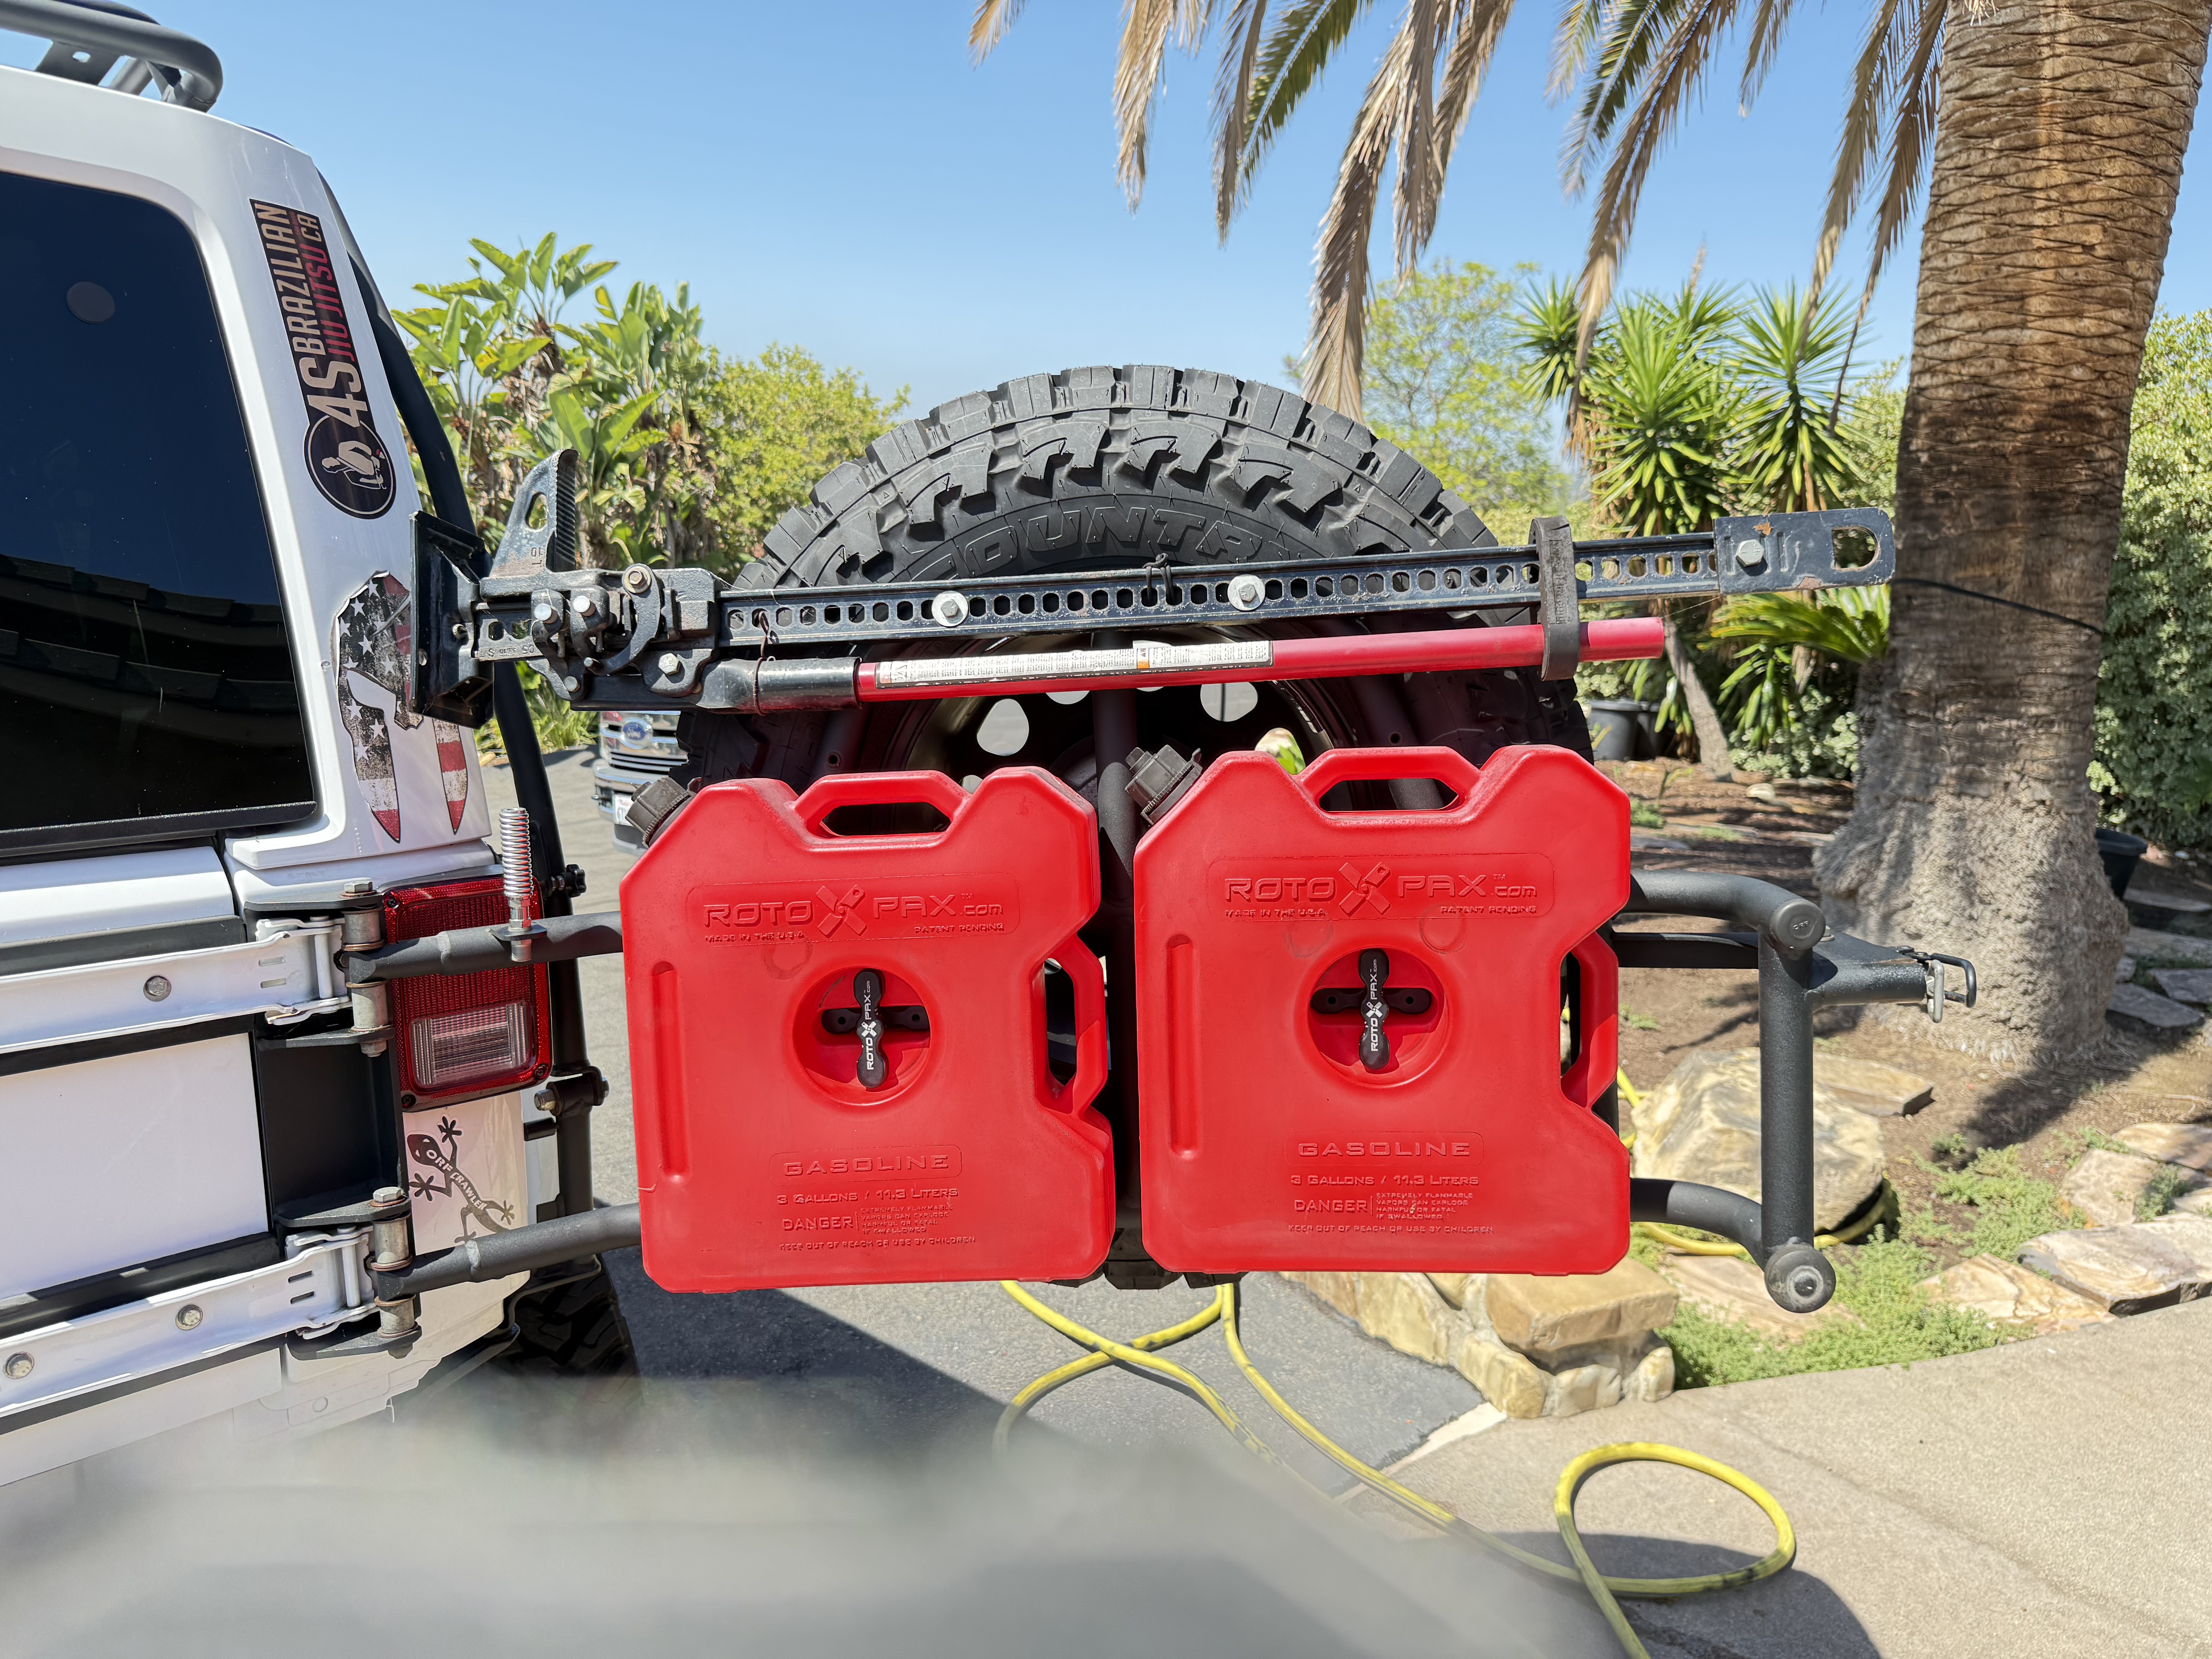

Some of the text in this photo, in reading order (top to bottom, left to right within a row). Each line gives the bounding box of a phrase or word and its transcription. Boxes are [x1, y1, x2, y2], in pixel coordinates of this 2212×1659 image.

[297, 214, 356, 362] JIU JITSU CA
[254, 203, 368, 428] 4S BRAZILIAN
[1225, 876, 1336, 903] ROTO
[703, 900, 814, 928] ROTO
[1260, 909, 1271, 917] IN
[1274, 909, 1295, 917] THE
[1489, 905, 1537, 914] PENDING
[914, 923, 1005, 933] PATENT PENDING
[705, 934, 736, 943] MADE
[754, 933, 774, 941] THE
[1370, 1018, 1378, 1051] ROTO
[866, 1037, 874, 1070] ROTO
[1298, 1142, 1470, 1157] GASOLINE
[426, 1149, 453, 1171] ORF
[783, 1155, 949, 1176] GASOLINE
[1290, 1175, 1302, 1185] 3
[1307, 1175, 1375, 1186] GALLONS
[1394, 1175, 1425, 1186] 11.3
[1430, 1175, 1479, 1186] LITERS
[450, 1172, 487, 1210] CRAWLER
[777, 1194, 788, 1205] 3
[793, 1192, 858, 1204] GALLONS
[876, 1189, 906, 1200] 11.3
[911, 1188, 959, 1198] LITERS
[1294, 1200, 1367, 1212] DANGER
[782, 1216, 853, 1231] DANGER
[780, 1243, 803, 1251] KEEP
[929, 1237, 976, 1245] CHILDREN
